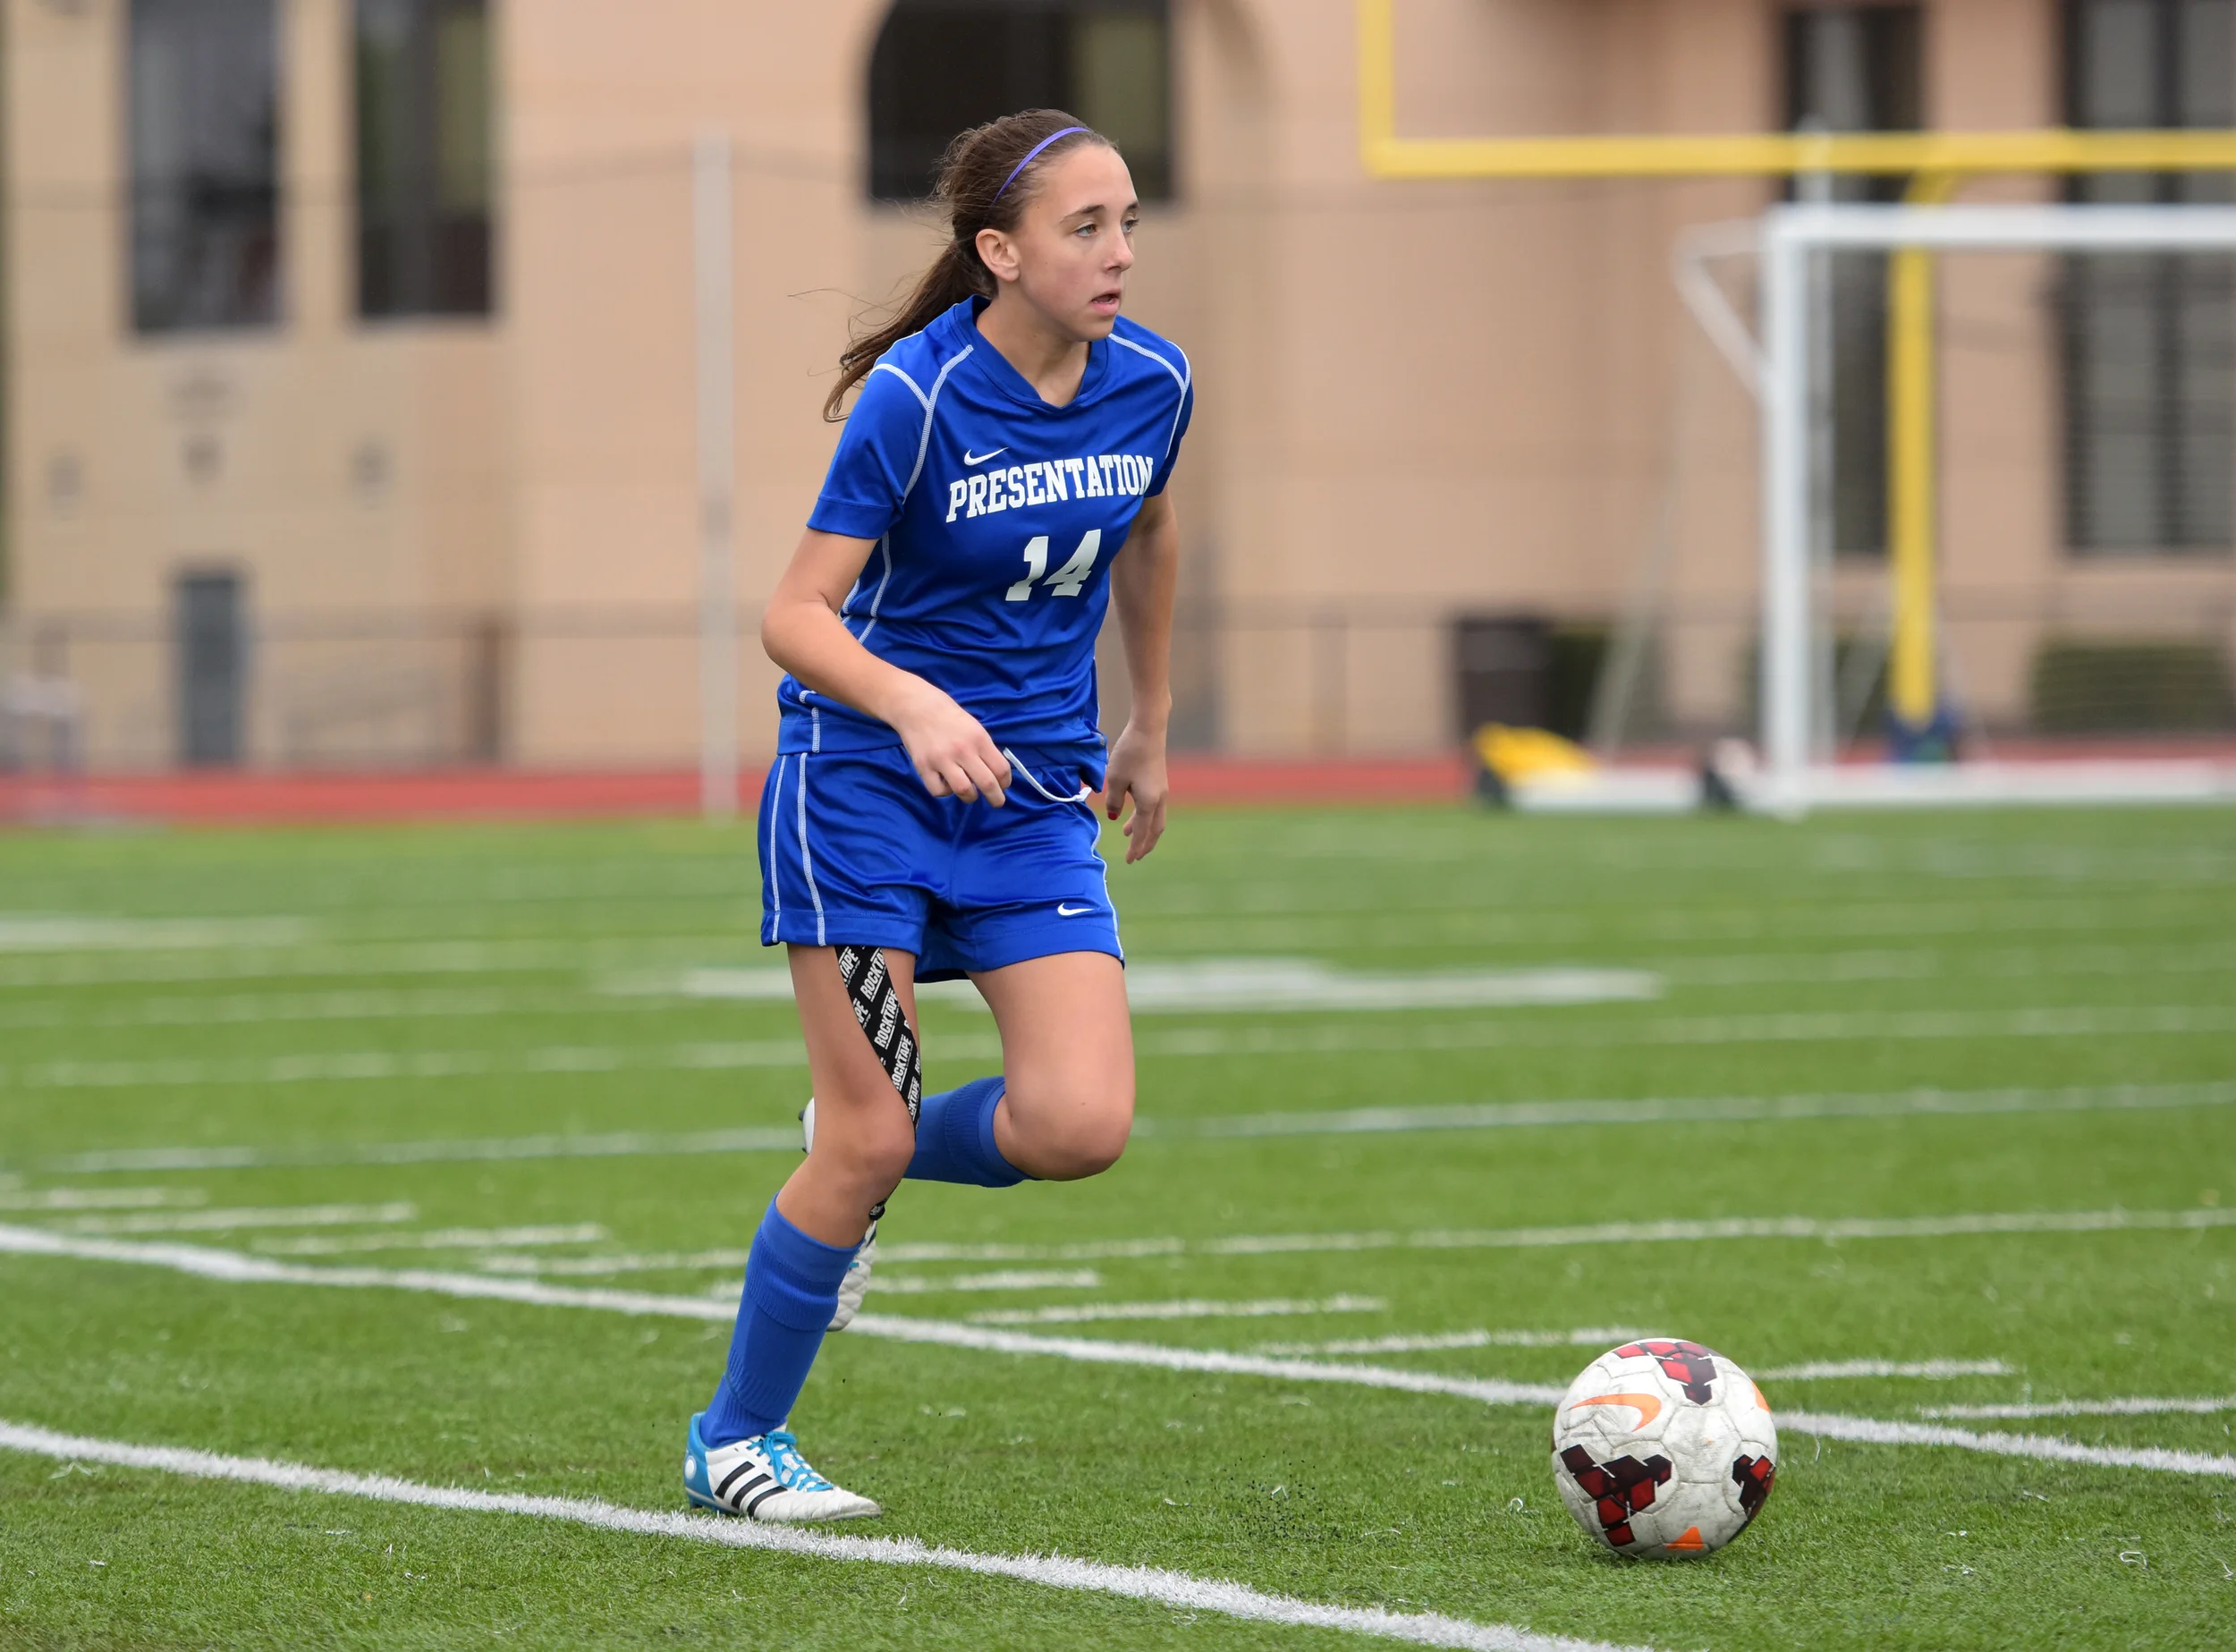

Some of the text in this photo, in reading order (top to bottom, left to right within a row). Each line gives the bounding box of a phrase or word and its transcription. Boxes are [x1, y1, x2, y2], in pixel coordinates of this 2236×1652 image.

[945, 454, 1154, 523] PRESENTATION
[1005, 529, 1101, 601] 14
[840, 948, 860, 982] TAPE
[860, 949, 885, 1000] ROCKTA
